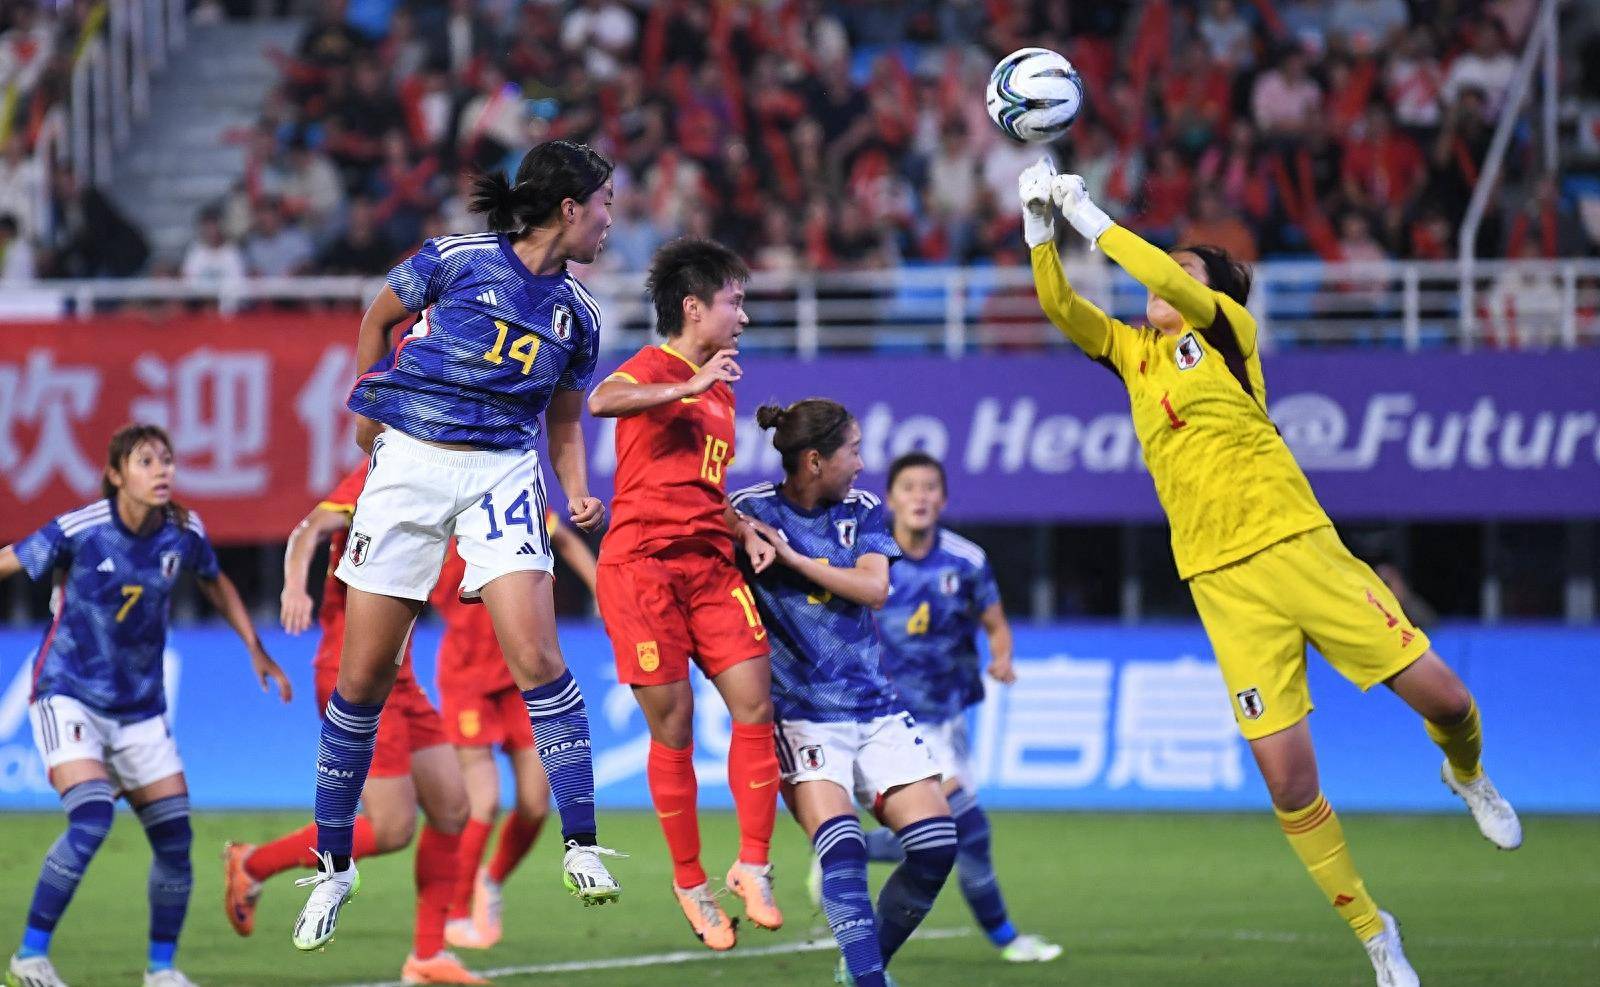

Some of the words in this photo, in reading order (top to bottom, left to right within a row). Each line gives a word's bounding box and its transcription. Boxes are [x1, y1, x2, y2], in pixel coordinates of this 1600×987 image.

[483, 320, 541, 376] 14
[0, 345, 362, 503] 欢迎
[861, 400, 949, 475] to
[963, 395, 1149, 475] Hea
[1268, 391, 1600, 471] @Futur
[1160, 391, 1187, 430] 1
[701, 433, 729, 484] 19
[480, 489, 534, 541] 14
[115, 584, 144, 623] 7
[731, 584, 763, 628] 1
[906, 600, 931, 636] 4
[1366, 588, 1400, 628] 1
[973, 655, 1246, 791] 信息
[541, 738, 592, 759] JAPAN
